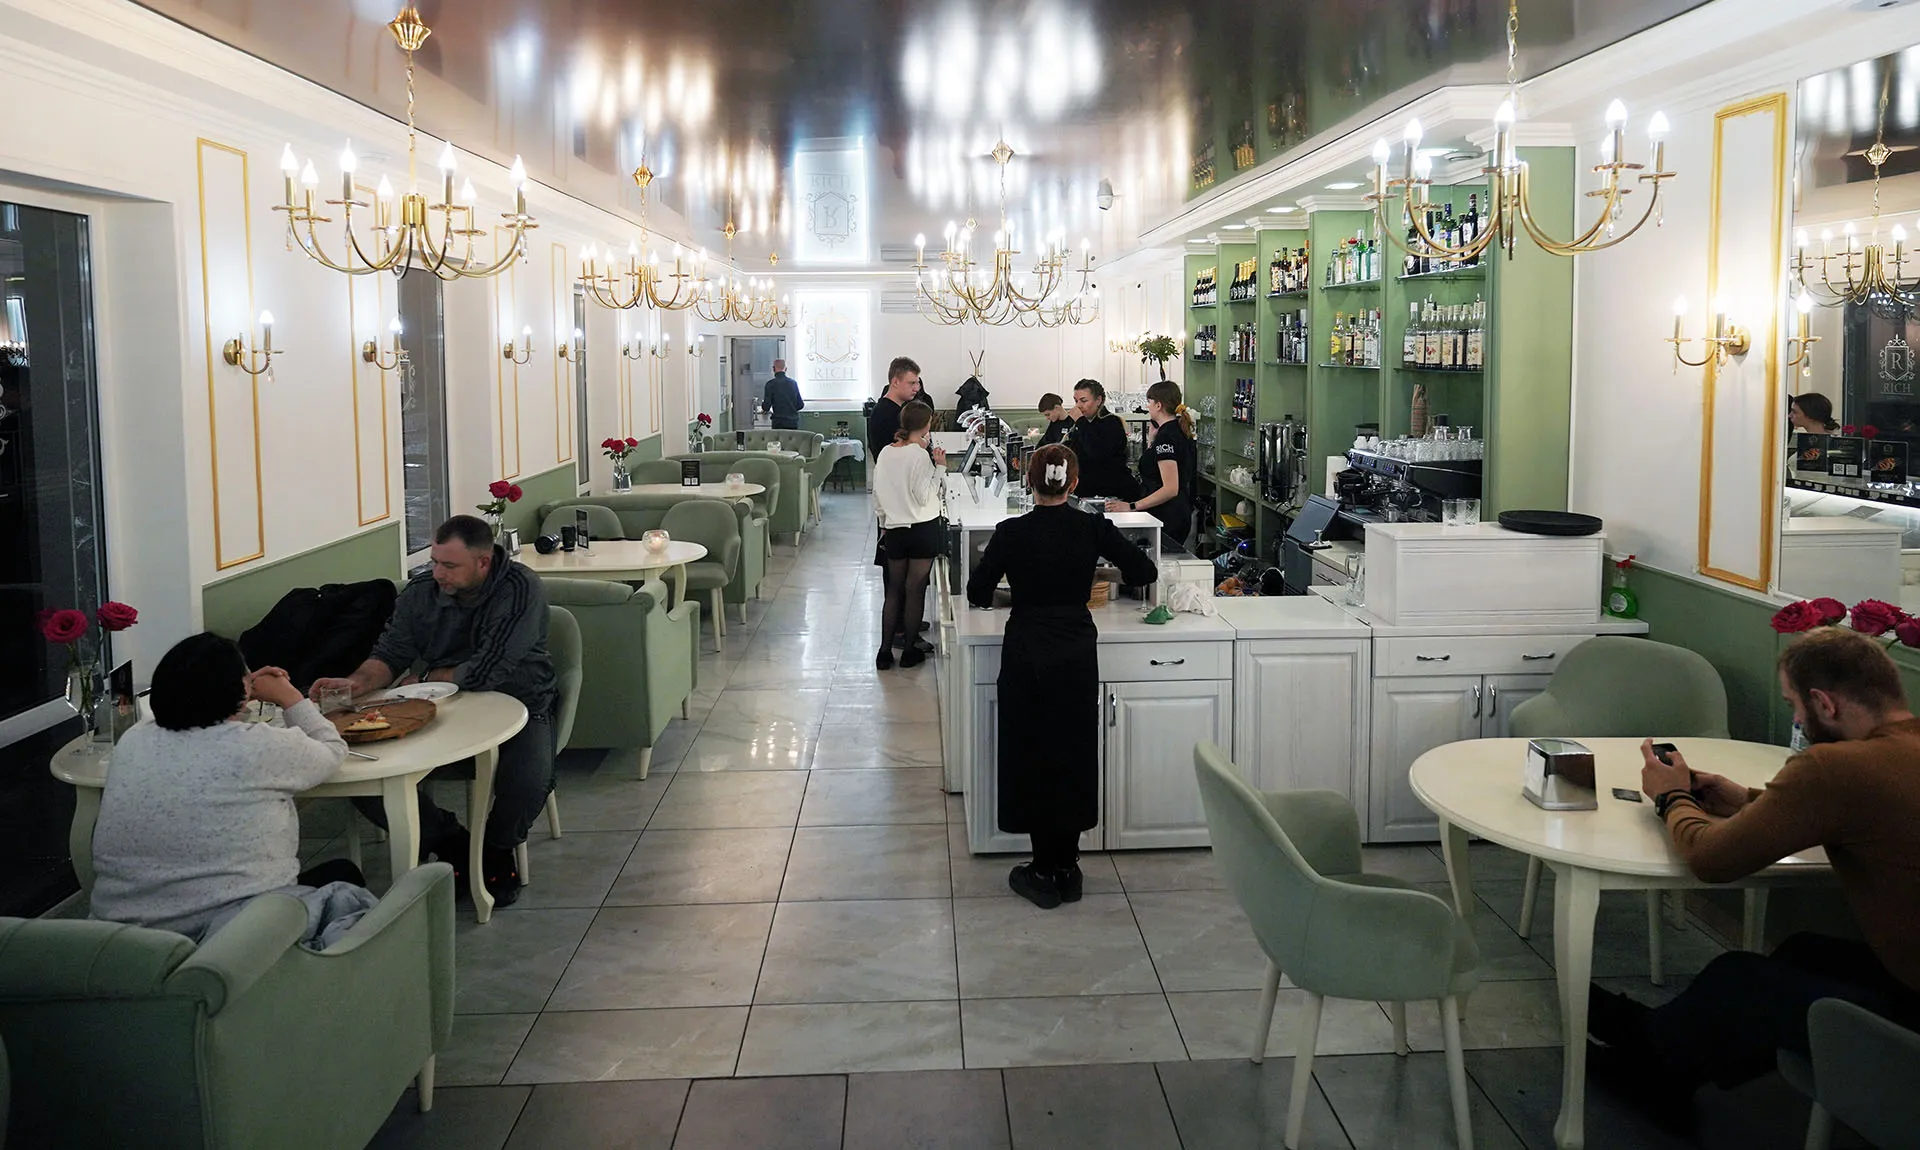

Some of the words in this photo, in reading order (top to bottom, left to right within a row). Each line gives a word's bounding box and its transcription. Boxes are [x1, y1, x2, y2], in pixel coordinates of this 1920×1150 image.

[825, 328, 841, 349] R
[1891, 352, 1905, 371] R
[814, 367, 854, 379] RICH
[1883, 382, 1911, 393] RICH
[1155, 443, 1174, 452] RICH
